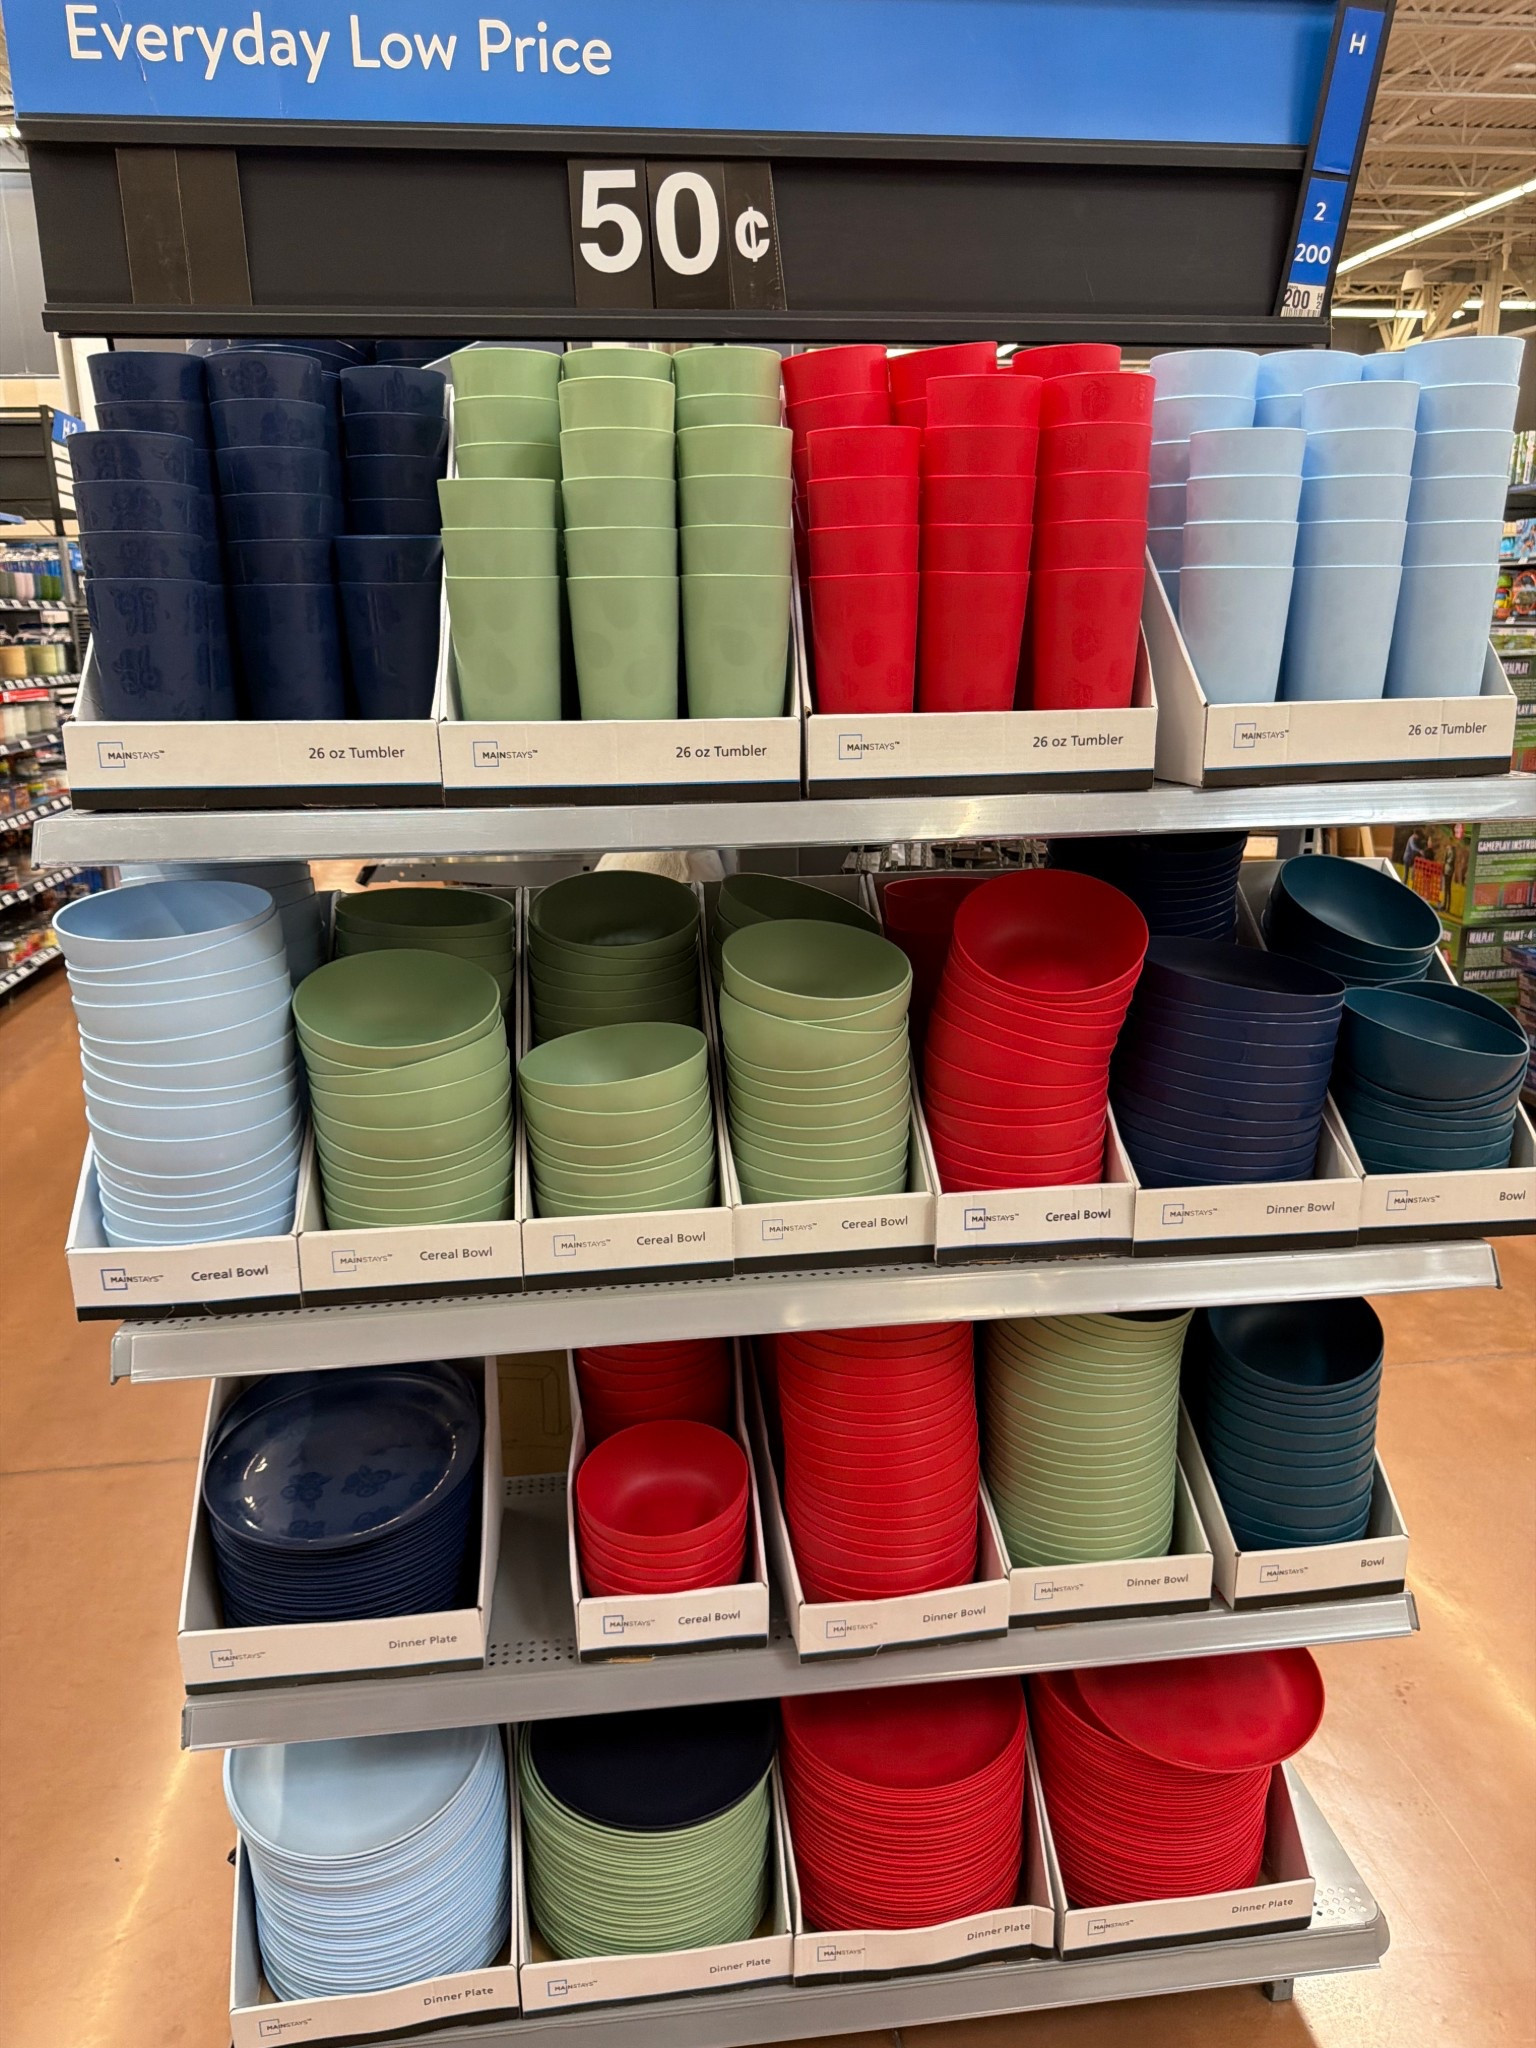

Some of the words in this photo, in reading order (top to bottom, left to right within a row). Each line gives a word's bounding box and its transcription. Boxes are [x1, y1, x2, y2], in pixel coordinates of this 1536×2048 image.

[65, 5, 330, 83] Everyday
[350, 15, 458, 71] Low
[479, 18, 612, 75] Price
[1349, 33, 1366, 55] H
[1313, 202, 1326, 221] 2
[1294, 243, 1331, 265] 200
[1282, 289, 1310, 309] 200
[1408, 724, 1421, 736] 26
[1424, 726, 1438, 735] oz
[1441, 722, 1487, 735] Tumbler
[1033, 736, 1048, 748] 26
[1052, 738, 1067, 747] oz
[1071, 734, 1123, 746] Tumbler
[309, 747, 325, 760] 26
[329, 750, 346, 759] oz
[349, 746, 405, 759] Tumbler
[676, 747, 691, 758] 26
[695, 749, 710, 758] oz
[714, 745, 767, 757] Tumbler
[1499, 1190, 1526, 1201] Bowl
[1045, 1210, 1080, 1223] Cereal
[1084, 1208, 1111, 1220] Bowl
[1266, 1202, 1304, 1215] Dinner
[1307, 1201, 1335, 1213] Bowl
[841, 1218, 877, 1230] Cereal
[880, 1215, 908, 1227] Bowl
[636, 1233, 673, 1246] Cereal
[677, 1231, 706, 1244] Bowl
[419, 1248, 458, 1261] Cereal
[462, 1246, 493, 1259] Bowl
[191, 1267, 232, 1282] Cereal
[236, 1265, 269, 1278] Bowl
[1360, 1557, 1384, 1568] Bowl
[1126, 1576, 1161, 1588] Dinner
[1163, 1573, 1189, 1585] Bowl
[678, 1613, 711, 1625] Cereal
[714, 1610, 741, 1622] Bowl
[922, 1611, 958, 1624] Dinner
[960, 1606, 986, 1619] Bowl
[388, 1638, 427, 1650] Dinner
[430, 1634, 458, 1645] Plate
[1231, 1904, 1266, 1914] Dinner
[1268, 1898, 1294, 1909] Plate
[967, 1928, 1002, 1941] Dinner
[1004, 1923, 1031, 1933] Plate
[709, 1963, 743, 1974] Dinner
[746, 1957, 771, 1968] Plate
[423, 1992, 462, 2006] Dinner
[465, 1986, 494, 1999] Plate
